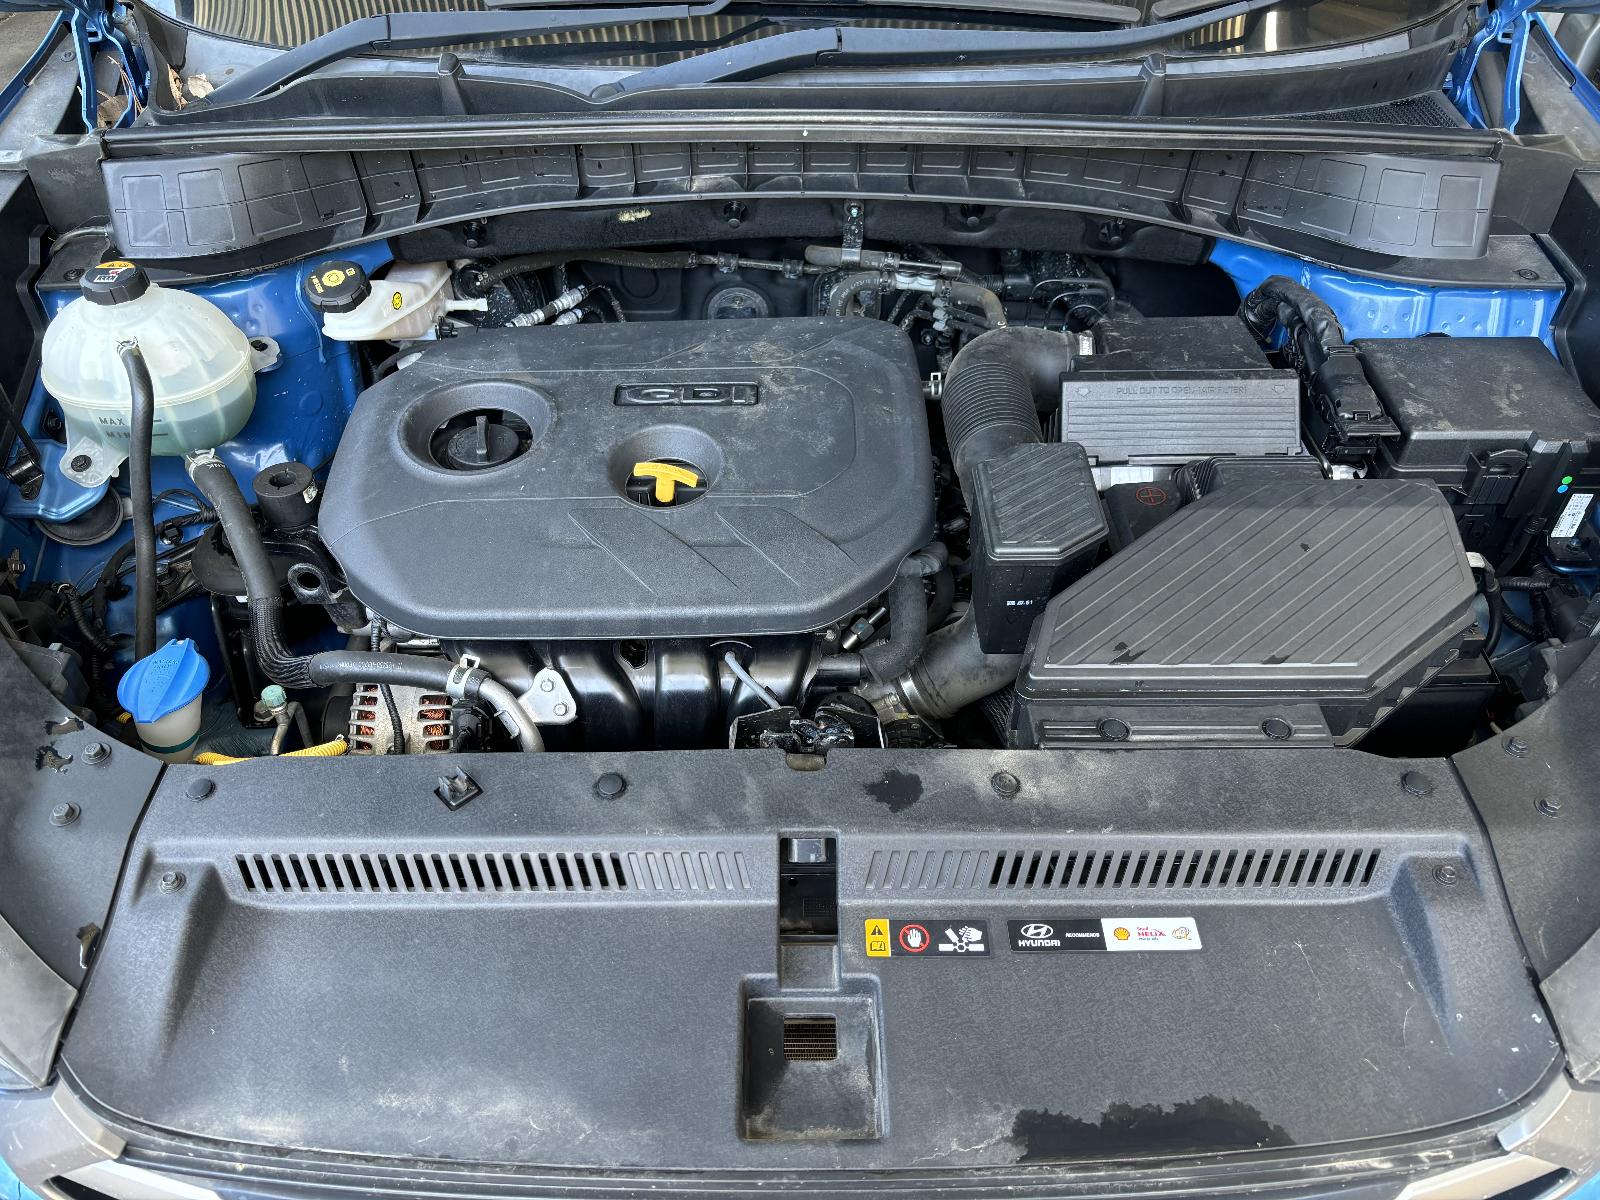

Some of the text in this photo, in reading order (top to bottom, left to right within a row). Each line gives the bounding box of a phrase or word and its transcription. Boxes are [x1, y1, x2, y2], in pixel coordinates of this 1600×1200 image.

[1116, 387, 1138, 395] PULL
[1139, 387, 1157, 395] OUT
[1158, 386, 1170, 395] TO
[626, 386, 748, 405] GDI
[98, 416, 125, 426] MAX
[1137, 929, 1167, 937] HELIX
[1018, 939, 1061, 947] HYUNDAI
